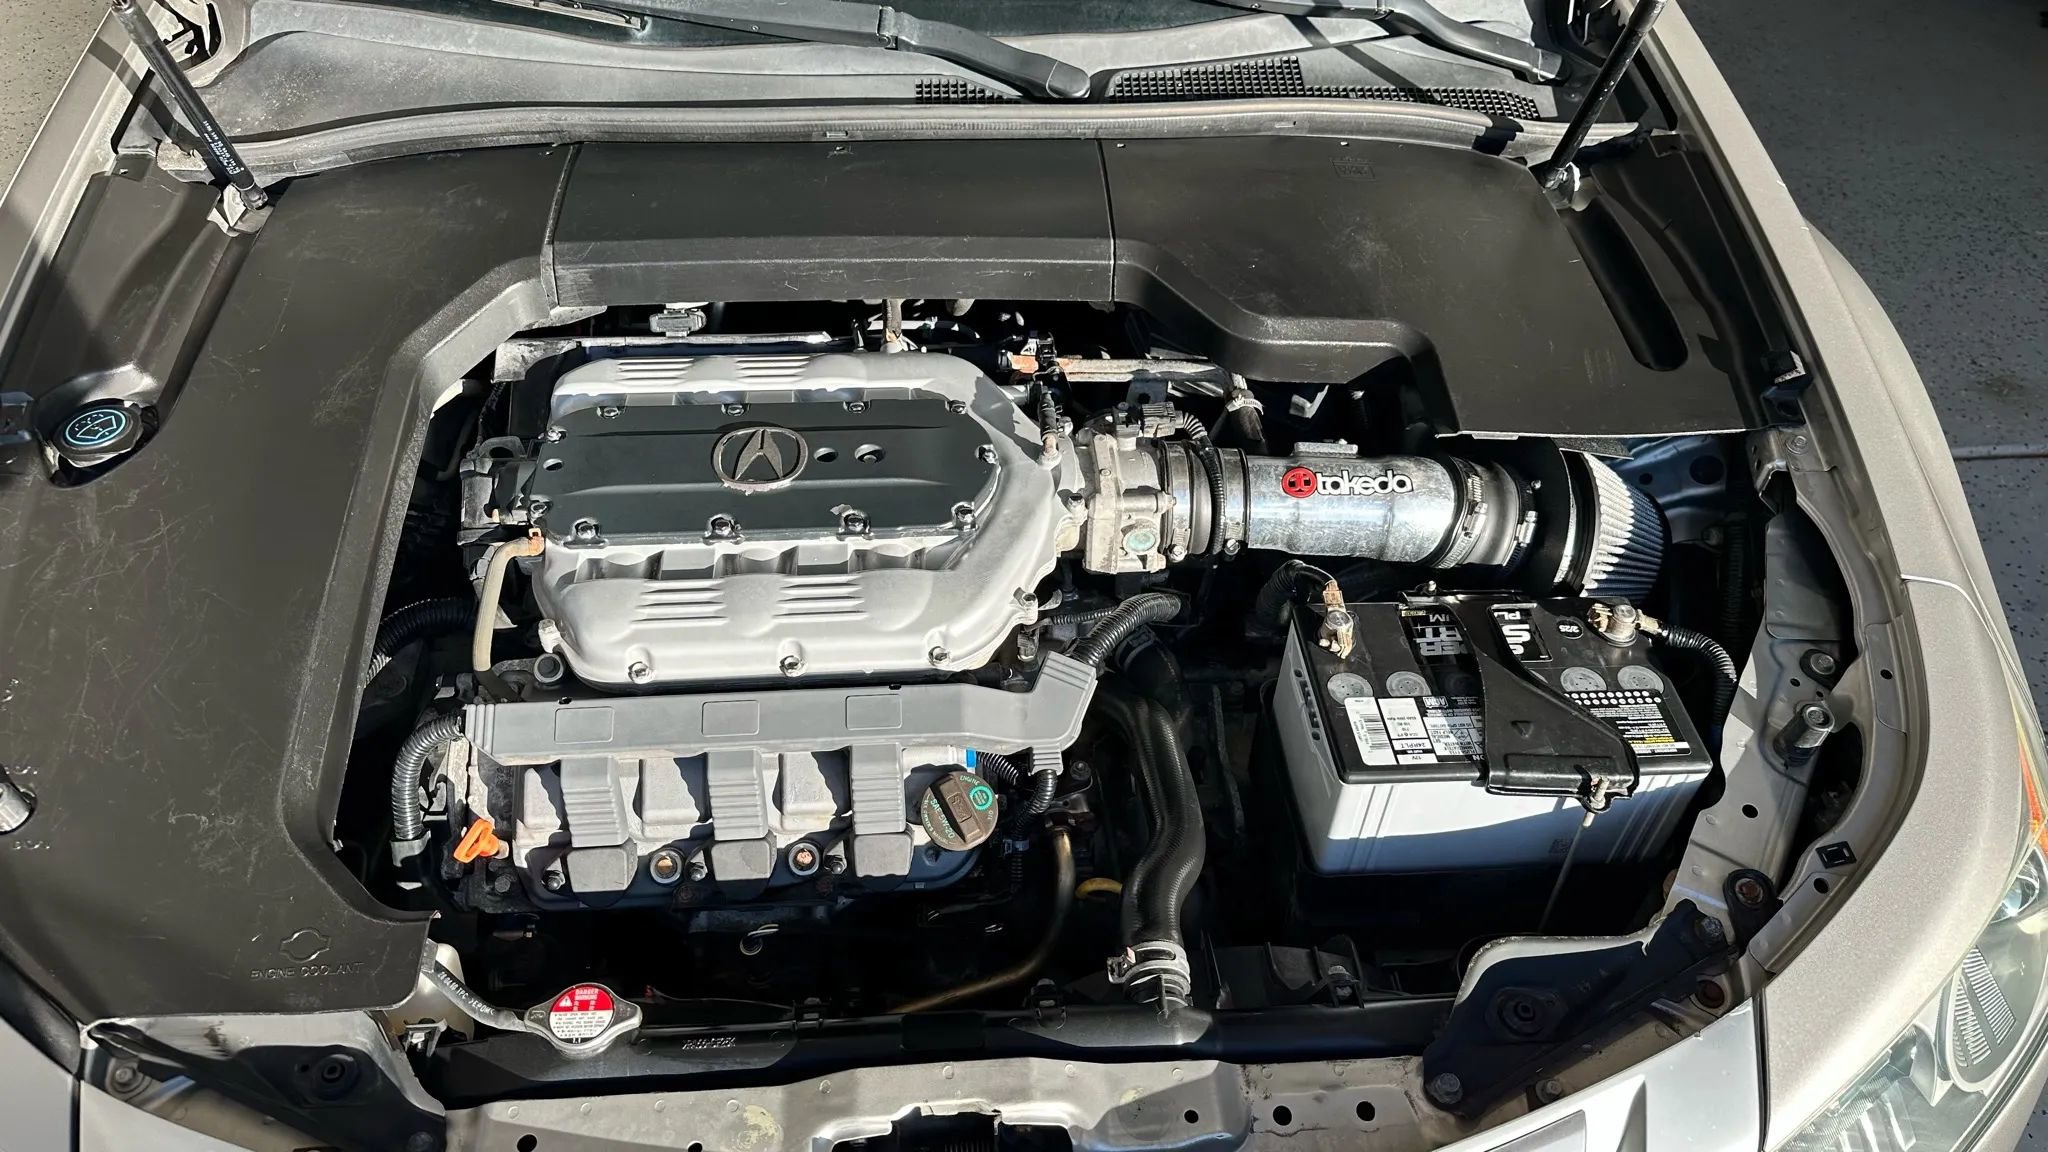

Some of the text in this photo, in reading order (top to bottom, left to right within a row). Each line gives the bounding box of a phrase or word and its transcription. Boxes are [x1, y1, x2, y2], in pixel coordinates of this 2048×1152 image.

[1315, 469, 1414, 496] takeda
[960, 775, 980, 785] ENGINE
[930, 799, 955, 838] SAE 5W-20
[250, 963, 364, 979] ENGINE COOLANT
